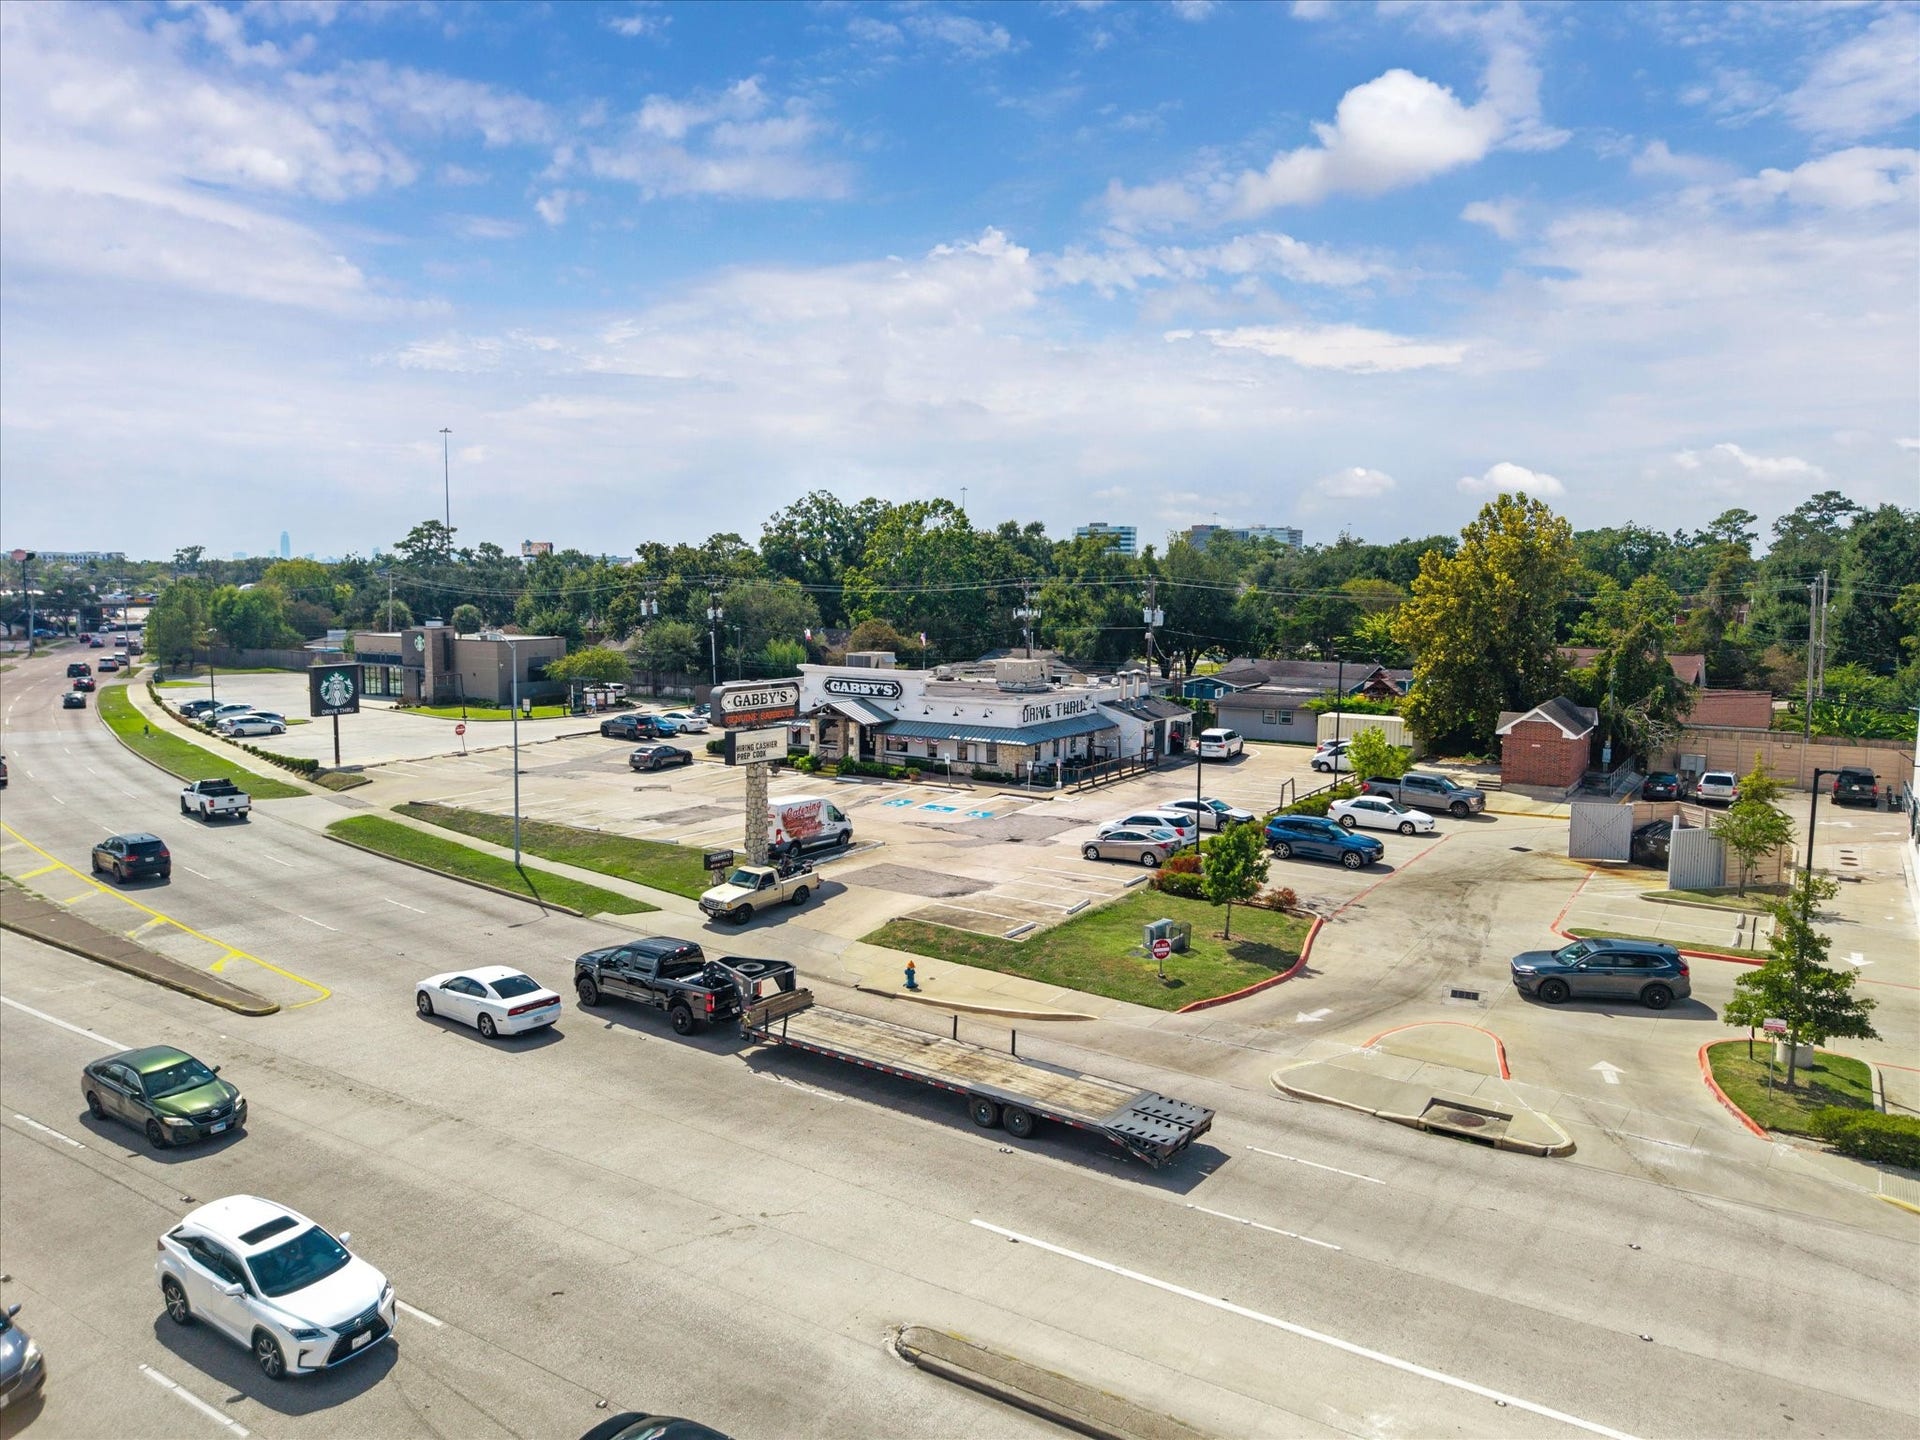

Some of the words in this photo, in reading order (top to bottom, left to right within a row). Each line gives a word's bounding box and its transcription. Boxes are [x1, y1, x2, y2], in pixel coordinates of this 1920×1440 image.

[829, 681, 894, 696] GABBY'S
[733, 691, 788, 708] GABBY'S
[1022, 704, 1051, 723] DRIVE
[1055, 699, 1084, 717] THRU
[736, 744, 754, 752] HIRING
[755, 741, 778, 750] CASHIER
[736, 752, 751, 760] PREP
[752, 750, 767, 759] COOK
